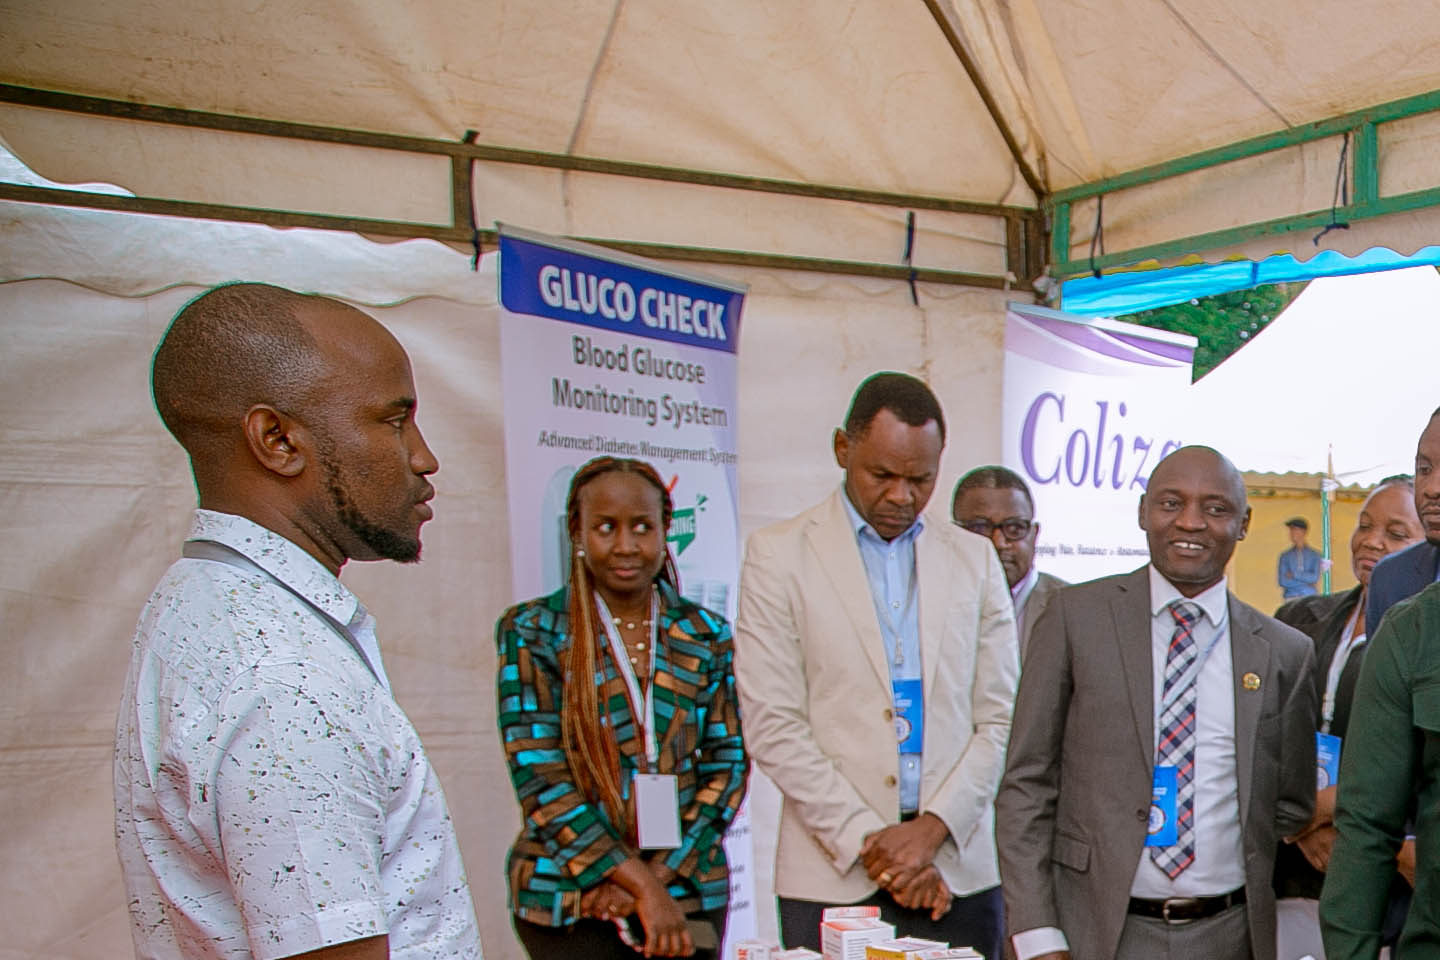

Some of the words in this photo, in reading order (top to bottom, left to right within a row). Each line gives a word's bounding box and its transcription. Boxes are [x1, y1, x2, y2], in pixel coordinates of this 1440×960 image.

[538, 264, 636, 323] GLUCO
[640, 288, 727, 341] CHECK
[572, 335, 629, 373] Blood
[632, 348, 706, 384] Glucose
[552, 377, 657, 427] Monitoring
[661, 394, 728, 429] System
